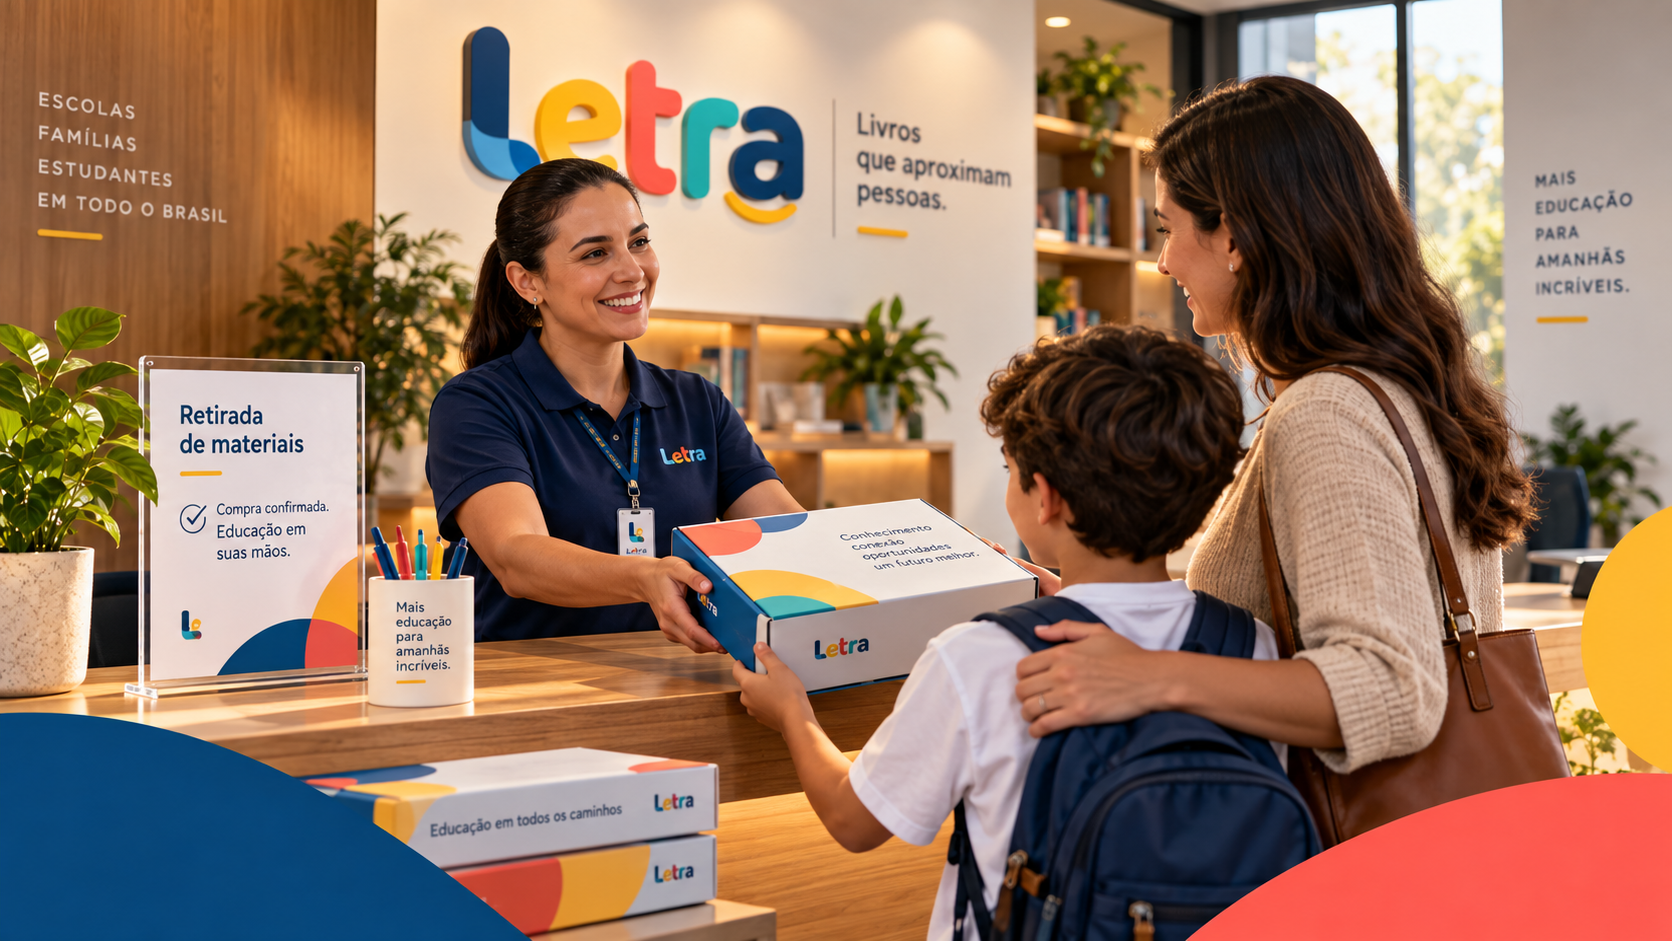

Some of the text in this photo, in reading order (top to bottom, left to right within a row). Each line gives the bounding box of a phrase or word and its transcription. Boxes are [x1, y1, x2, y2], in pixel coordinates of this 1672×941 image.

[38, 91, 136, 120] ESCOLAS
[462, 26, 804, 202] Letra
[857, 111, 922, 143] Livros
[38, 125, 137, 152] FAMÍLIAS
[38, 158, 173, 187] ESTUDANTES
[857, 150, 1012, 188] que aproximam
[1535, 170, 1576, 188] MAIS
[857, 183, 947, 210] pessoas.
[1535, 190, 1633, 215] EDUCAÇÃO
[38, 192, 228, 223] EM TODO O BRASIL
[1535, 225, 1579, 241] PARA
[1535, 247, 1625, 268] AMANHÃS
[1535, 276, 1630, 296] INCRÍVEIS.
[180, 404, 264, 425] Retirada
[180, 433, 304, 454] de materiais
[660, 446, 707, 466] Letra
[216, 500, 330, 518] Compra confirmada.
[217, 523, 306, 541] Educação em
[839, 525, 932, 541] Conhecimento
[216, 544, 291, 561] suas mãos.
[862, 543, 952, 561] oportunidades
[873, 551, 980, 570] um futuro melhor.
[396, 601, 425, 613] Mais
[396, 615, 452, 629] educação
[396, 632, 424, 643] para
[814, 635, 870, 660] Letra
[396, 645, 450, 657] amanhãs
[396, 659, 451, 672] incríveis.
[654, 793, 694, 812] Letra
[430, 803, 623, 838] Educação em todos os caminhos
[654, 864, 694, 884] Letra
